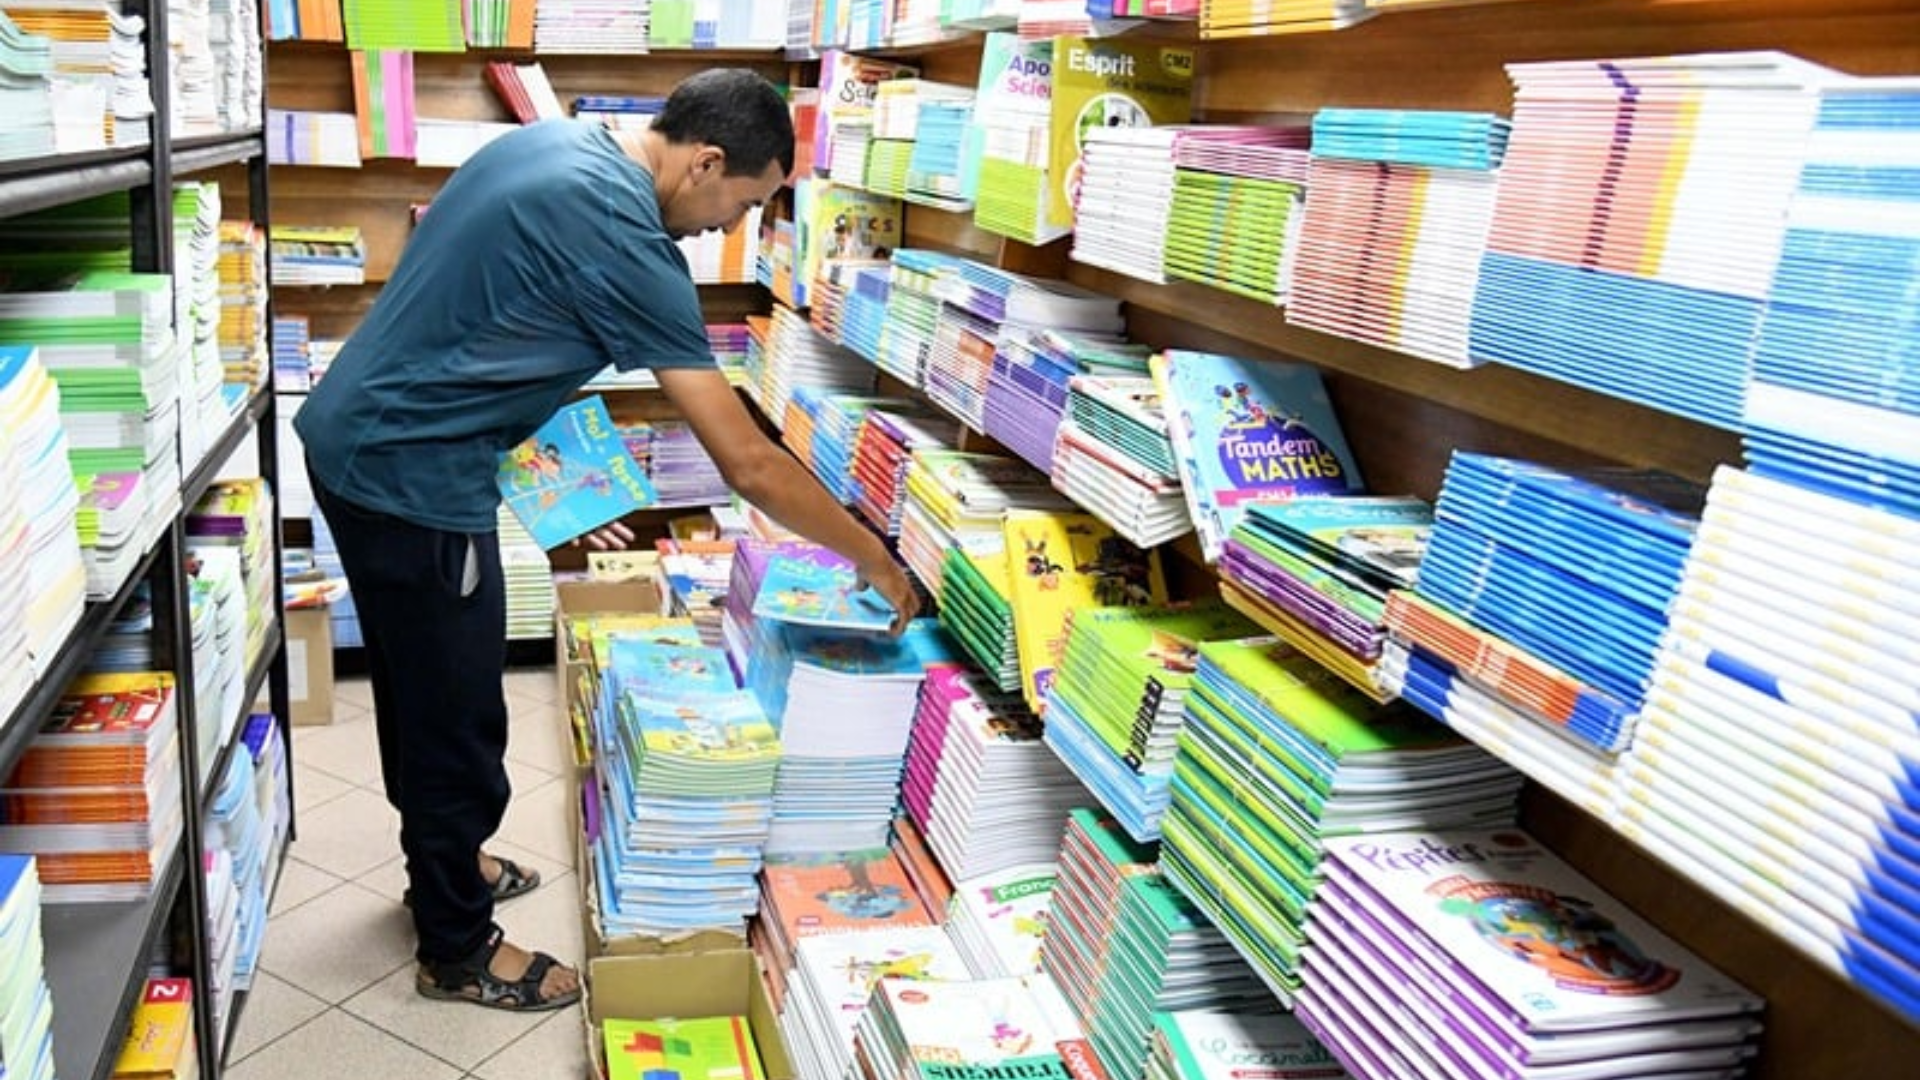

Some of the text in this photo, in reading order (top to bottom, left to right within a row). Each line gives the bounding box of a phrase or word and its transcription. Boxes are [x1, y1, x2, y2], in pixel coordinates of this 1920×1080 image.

[1069, 48, 1135, 77] Esprit
[1220, 433, 1320, 460] Tandem
[1239, 452, 1340, 482] MATHS
